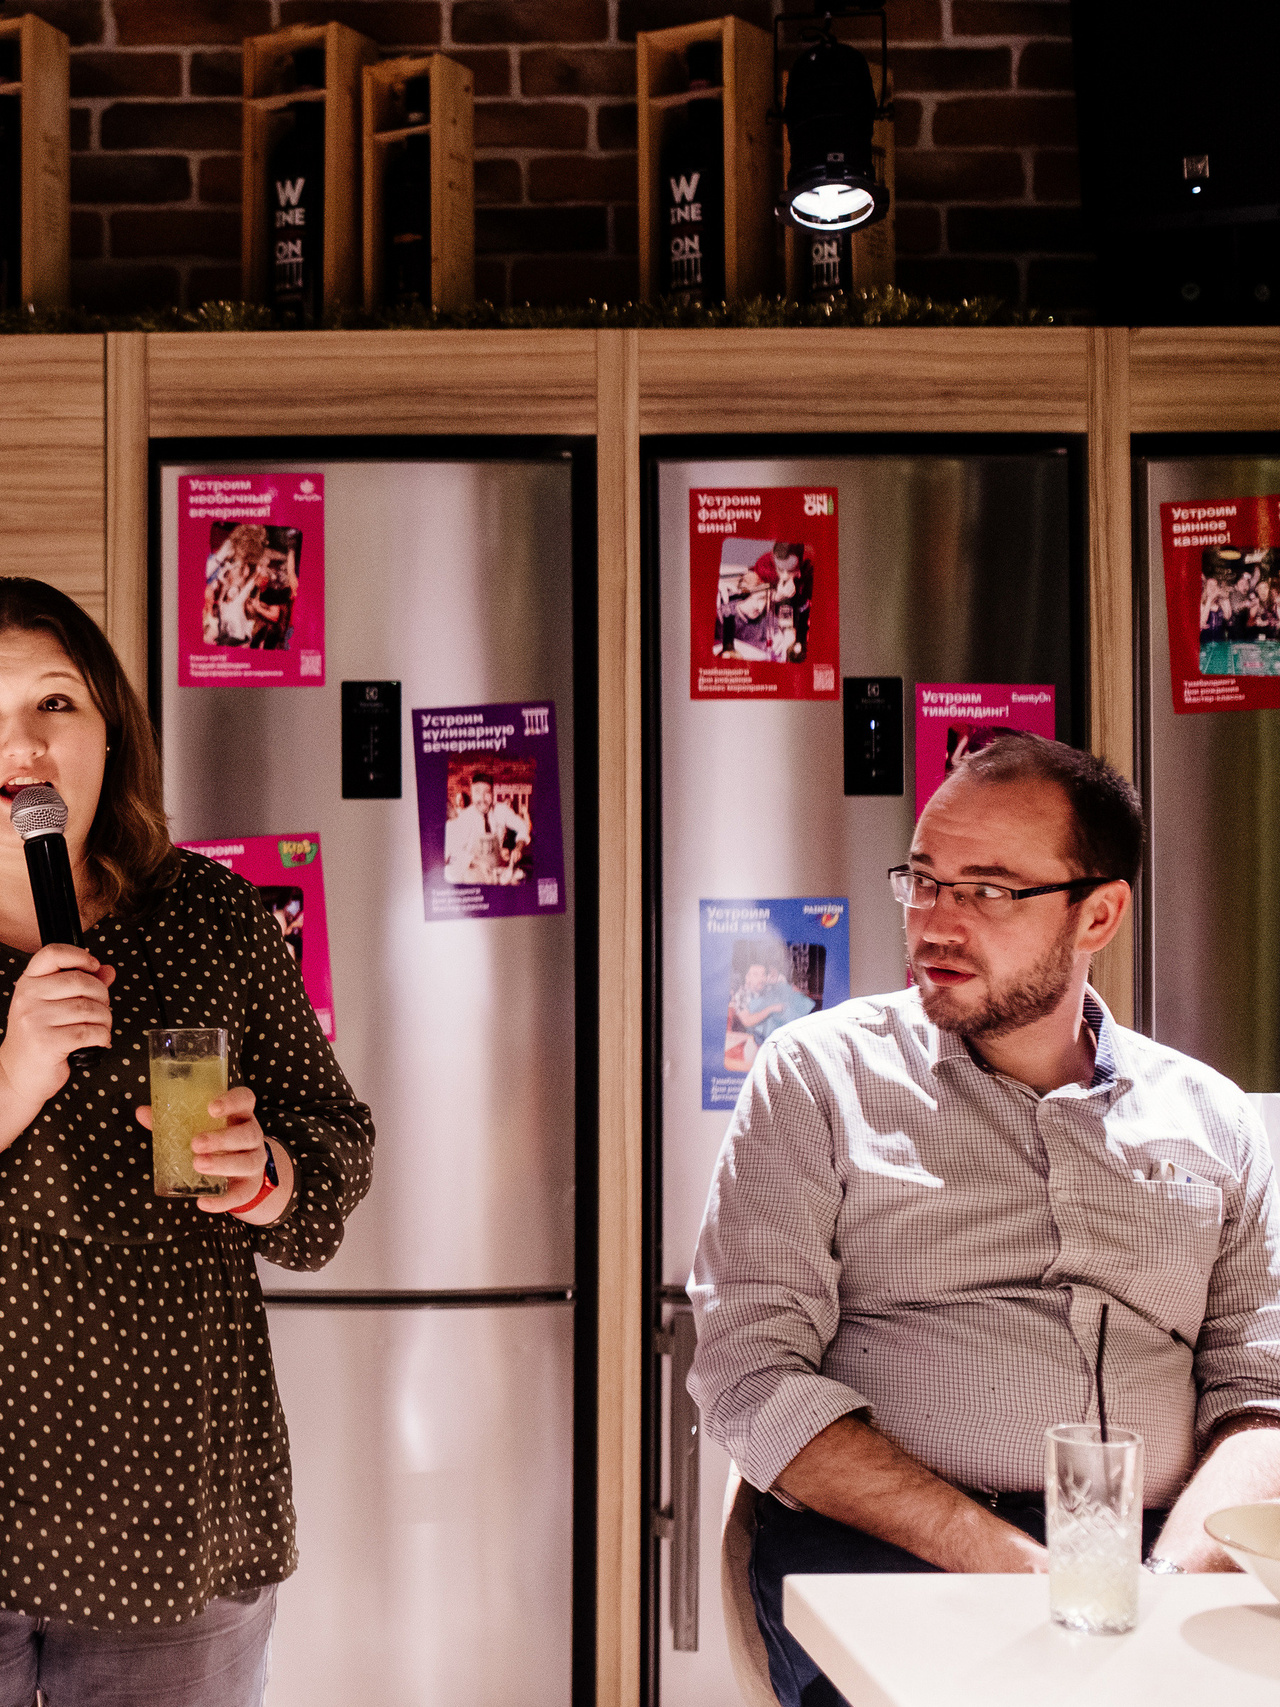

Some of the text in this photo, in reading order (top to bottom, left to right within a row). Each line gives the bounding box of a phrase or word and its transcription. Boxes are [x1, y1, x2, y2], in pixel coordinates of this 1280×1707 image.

[275, 177, 306, 207] W
[669, 171, 700, 203] W
[275, 239, 303, 260] ON
[671, 234, 700, 256] ON
[812, 241, 838, 260] ON
[189, 479, 252, 493] Устроим
[698, 493, 761, 508] Устроим
[188, 505, 271, 519] вечеринки!
[697, 507, 761, 522] фабрику
[804, 502, 828, 516] ON
[1172, 505, 1237, 521] Устроим
[697, 520, 737, 533] вина!
[1172, 520, 1227, 534] винное
[1173, 530, 1231, 547] казино!
[922, 690, 982, 705] Устроим
[922, 704, 1009, 719] тимбилдинг!
[422, 714, 484, 729] Устроим
[422, 724, 515, 741] кулинарную
[423, 736, 507, 753] вечеринку!
[707, 906, 770, 921] Устроим
[706, 920, 767, 933] fluid art!
